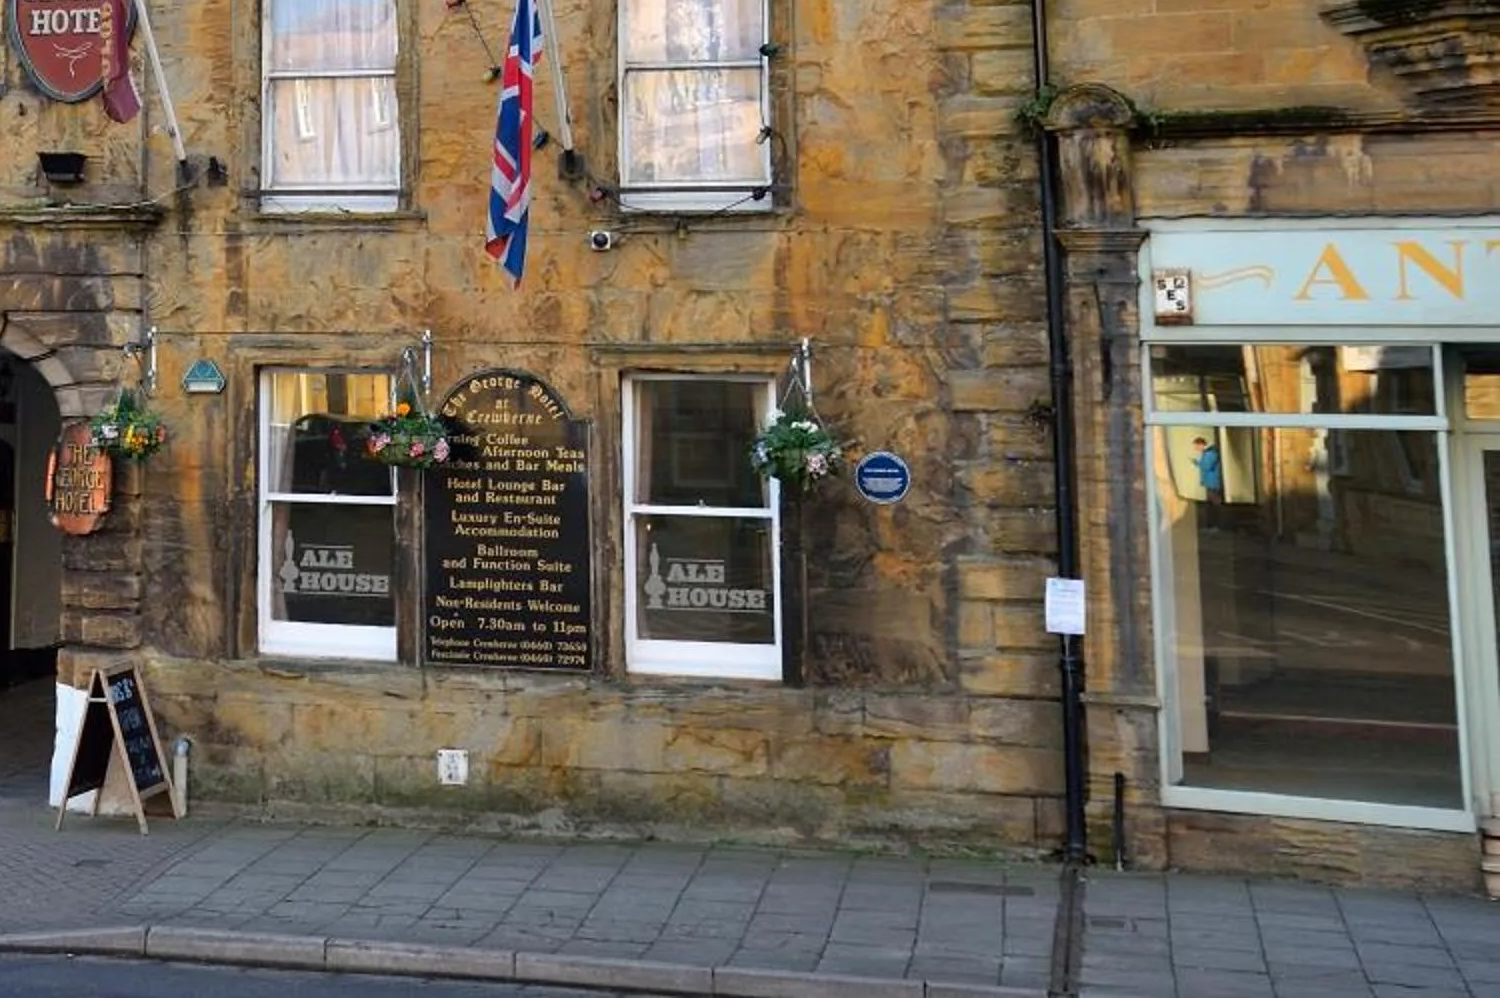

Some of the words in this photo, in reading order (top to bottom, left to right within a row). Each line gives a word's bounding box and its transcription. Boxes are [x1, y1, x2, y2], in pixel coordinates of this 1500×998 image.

[30, 8, 100, 35] HOTE
[469, 377, 522, 394] George
[528, 381, 565, 420] Hotel
[495, 399, 510, 410] at
[485, 433, 530, 446] Coffee
[481, 447, 550, 458] Afternoon
[555, 447, 585, 459] Teas
[485, 459, 509, 470] and
[516, 459, 540, 471] Bar
[546, 460, 585, 472] Meals
[447, 477, 481, 489] Hotel
[488, 478, 536, 493] Lounge
[541, 479, 566, 492] Bar
[455, 491, 479, 503] and
[451, 509, 499, 525] Luxury
[503, 511, 561, 526] En-Suite
[454, 524, 559, 539] Accommodation
[477, 543, 539, 558] Ballroom
[299, 549, 354, 569] ALE
[442, 557, 467, 569] and
[473, 558, 531, 572] Function
[537, 559, 573, 573] Suite
[666, 563, 725, 582] ALE
[300, 571, 389, 593] HOUSE
[450, 576, 534, 592] Lamplighters
[539, 579, 564, 593] Bar
[528, 599, 581, 613] Welcome
[667, 587, 766, 609] HOUSE
[429, 615, 466, 629] Open
[477, 617, 527, 632] 7.30am
[532, 620, 547, 632] to
[552, 621, 587, 635] 11pm
